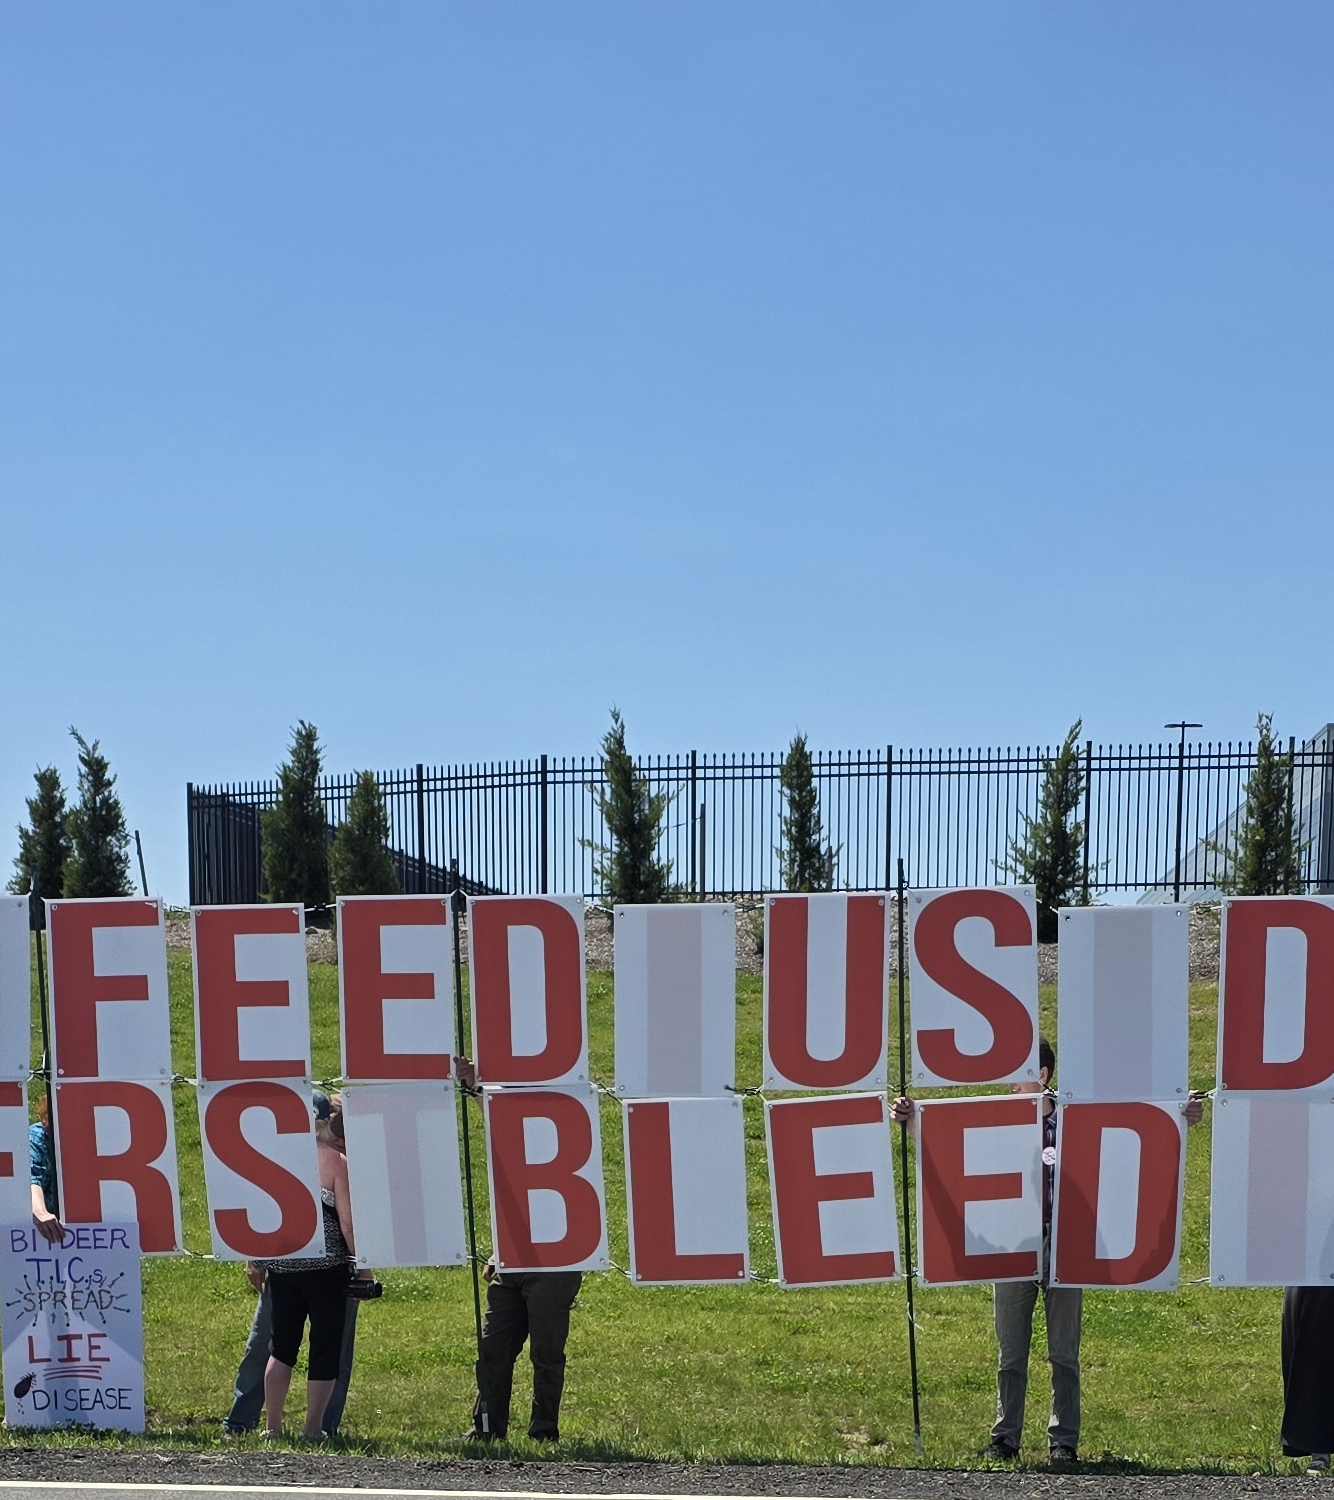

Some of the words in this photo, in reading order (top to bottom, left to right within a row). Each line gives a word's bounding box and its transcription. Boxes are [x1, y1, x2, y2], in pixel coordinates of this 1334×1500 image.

[50, 899, 584, 1082] FEED
[768, 889, 1035, 1088] US
[488, 1092, 1181, 1286] BLEED
[23, 1289, 115, 1312] SPREAD
[28, 1333, 110, 1364] LIE
[32, 1388, 133, 1411] DISEASE
